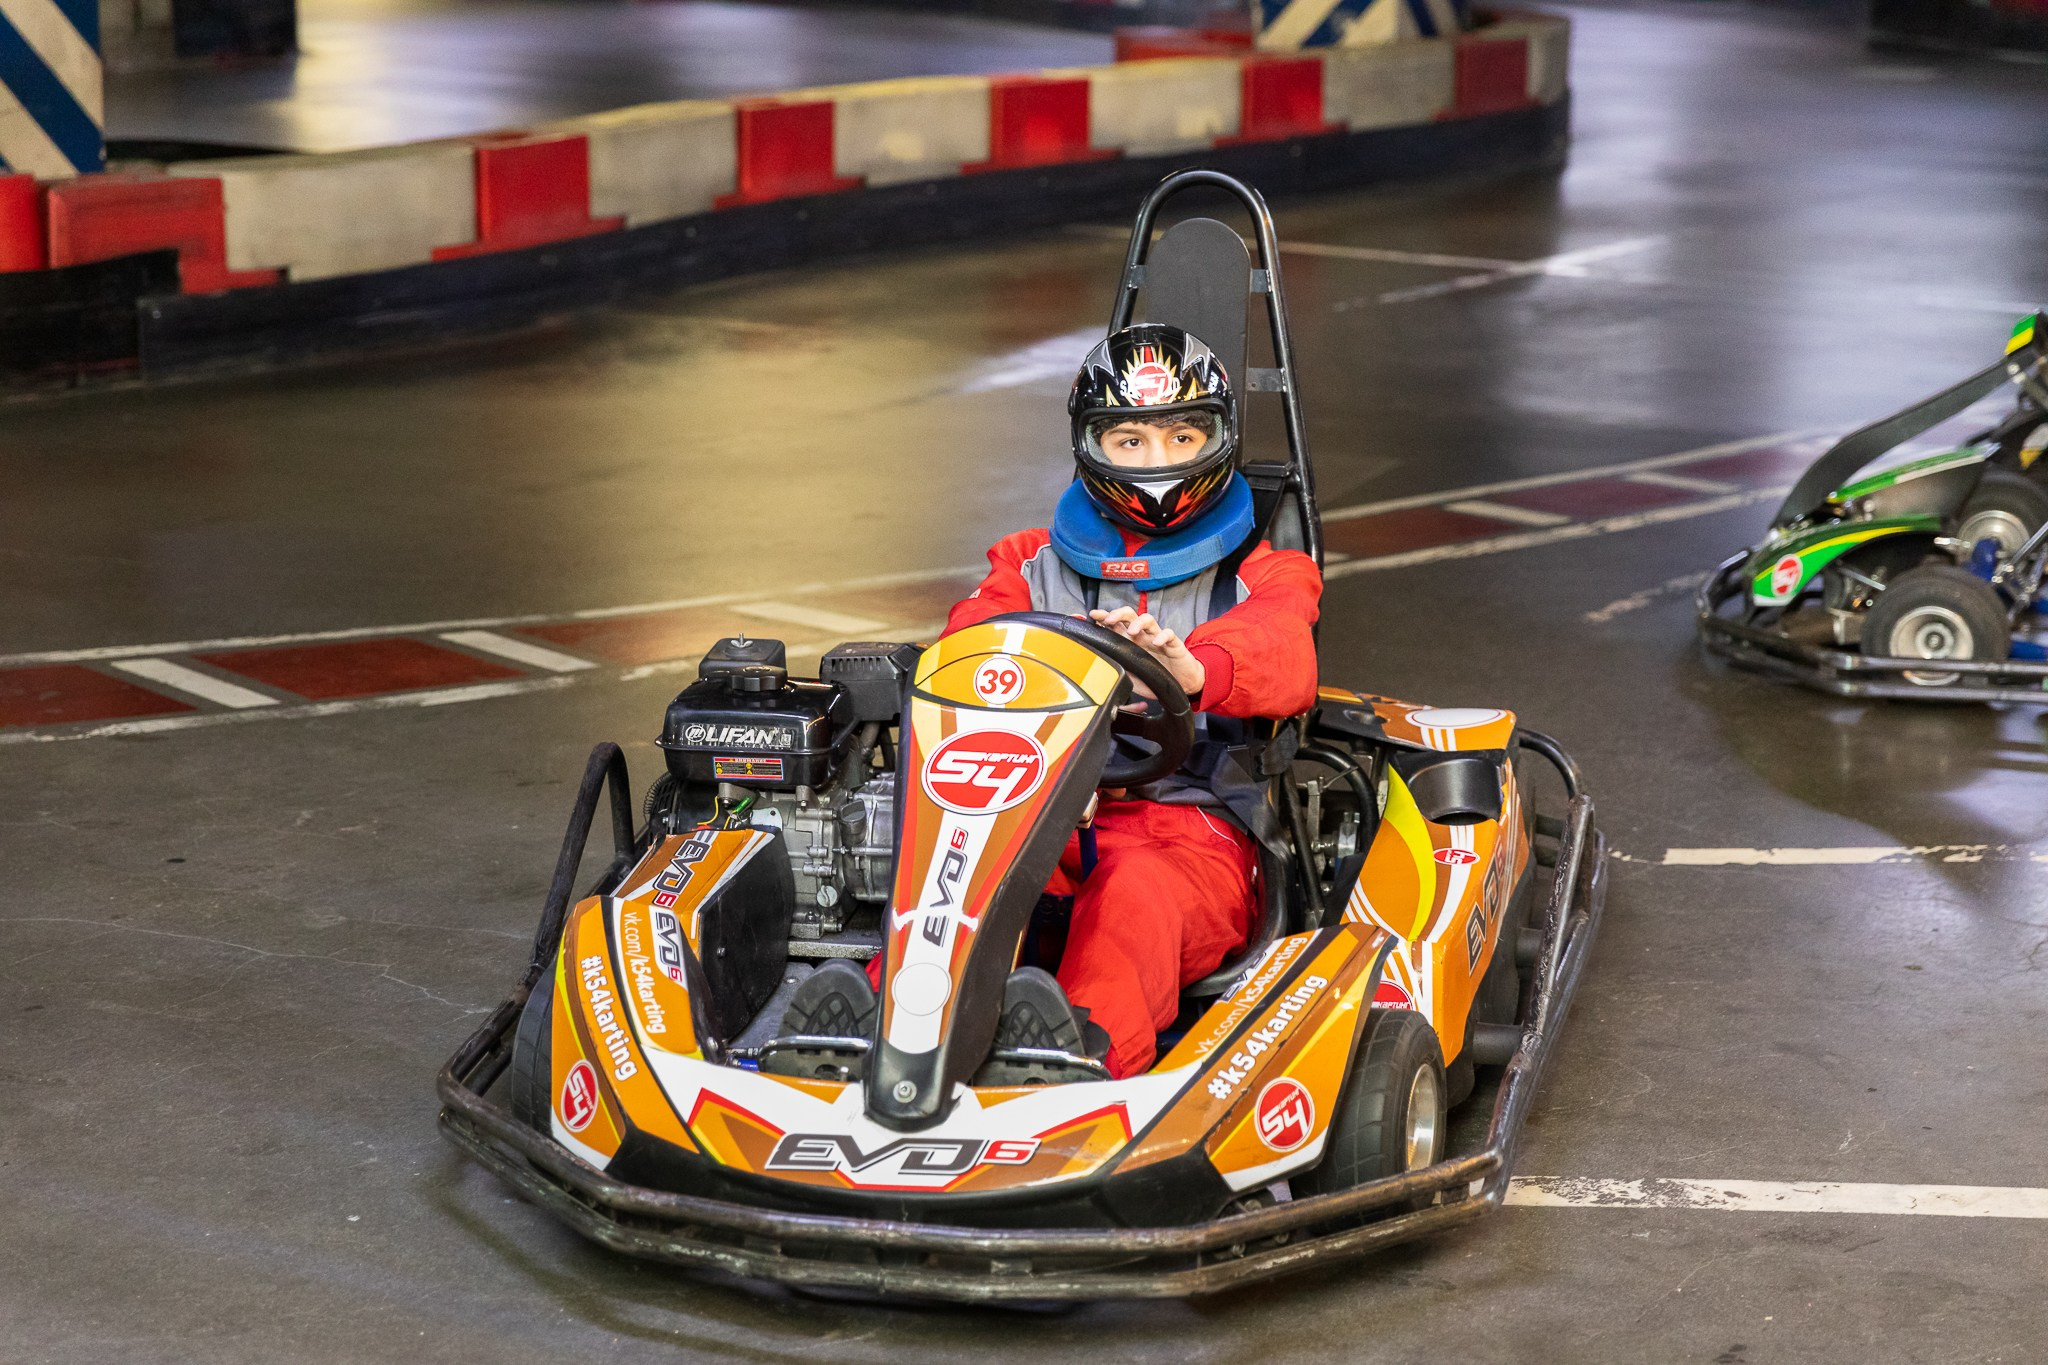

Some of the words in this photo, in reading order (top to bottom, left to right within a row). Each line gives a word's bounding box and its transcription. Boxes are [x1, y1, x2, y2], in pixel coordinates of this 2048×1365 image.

[1105, 563, 1146, 573] RLG
[979, 669, 1018, 695] 39
[705, 727, 777, 745] LIFAN
[929, 750, 1029, 808] 54
[624, 911, 667, 1035] vk.com/k54karting
[1195, 937, 1308, 1054] vk.com/k54karting
[581, 955, 639, 1081] #k54karting
[1207, 975, 1329, 1100] #k54karting
[567, 1069, 589, 1127] 54
[1262, 1098, 1308, 1141] 54
